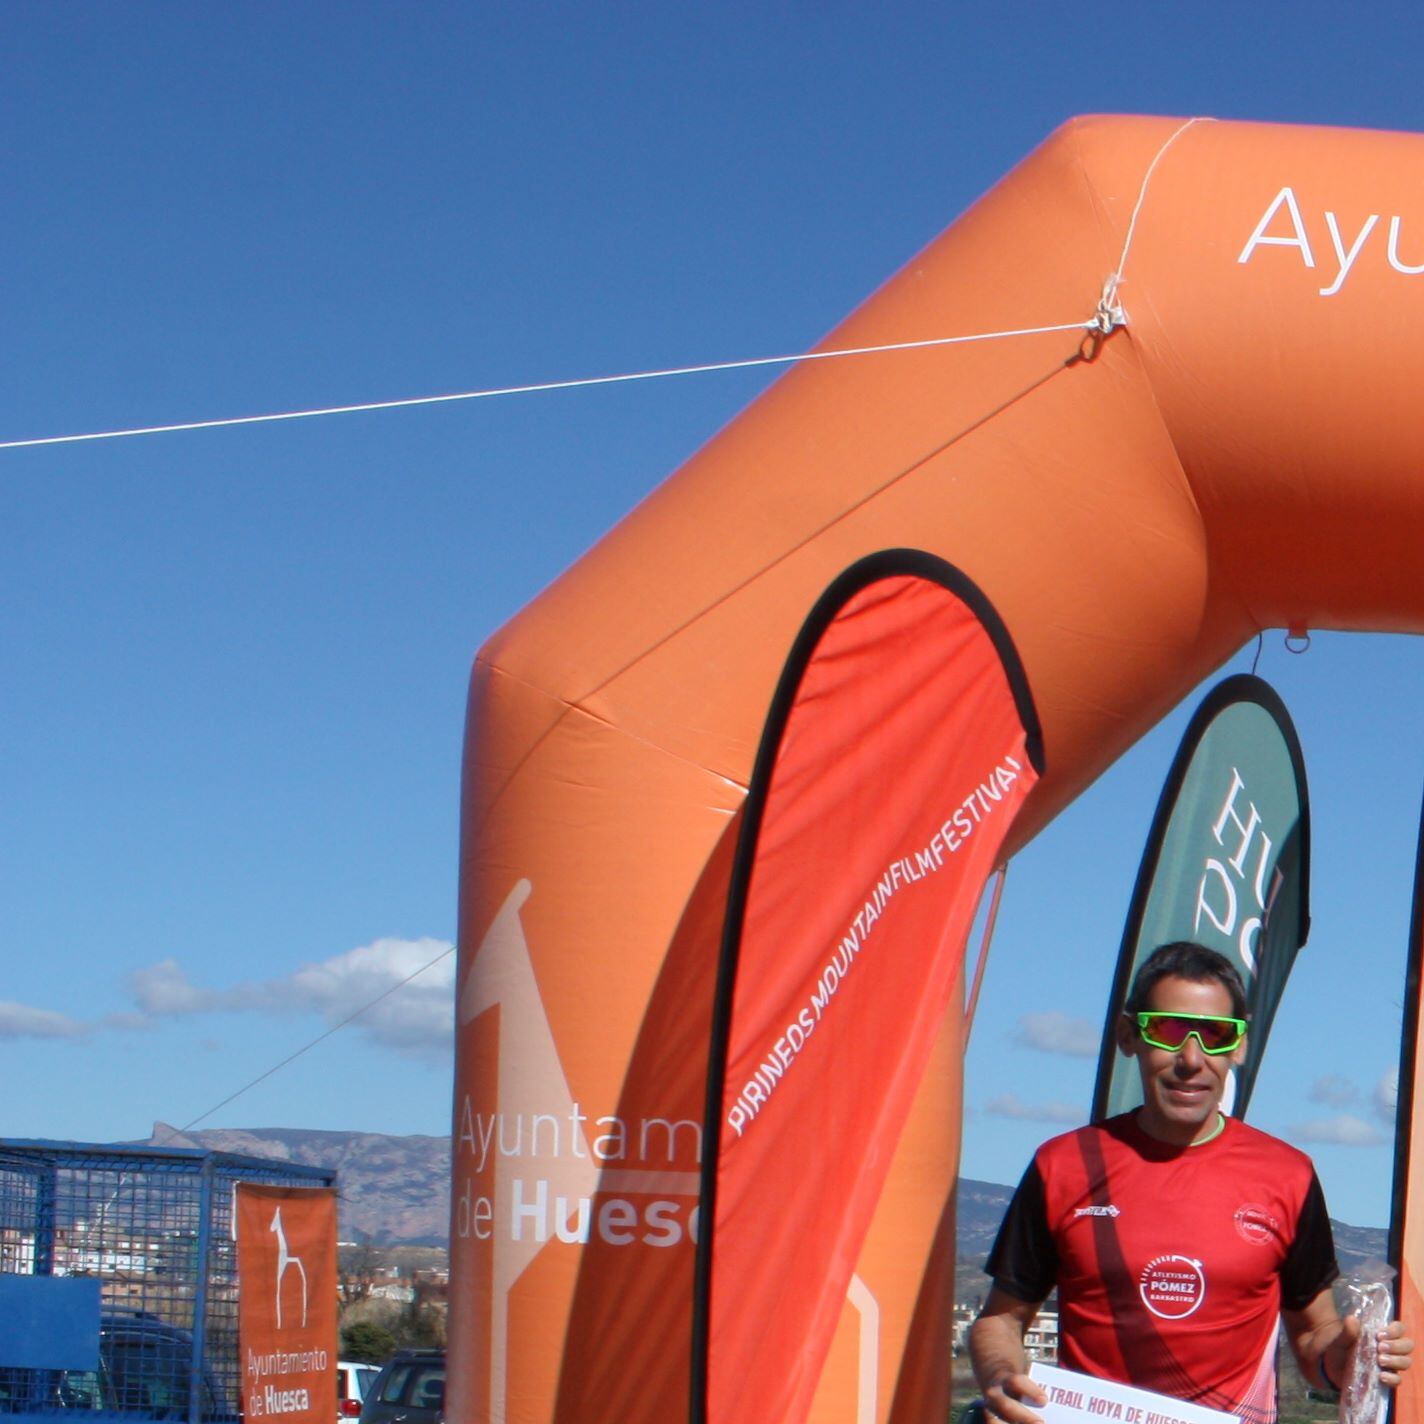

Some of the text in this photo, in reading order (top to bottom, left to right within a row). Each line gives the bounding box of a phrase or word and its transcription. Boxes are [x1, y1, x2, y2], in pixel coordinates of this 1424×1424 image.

[459, 1095, 702, 1173] Ayuntam
[457, 1178, 492, 1239] de
[1151, 1278, 1195, 1294] PÓMEZ
[248, 1344, 327, 1384] Ayuntamiento
[249, 1385, 310, 1416] de Huesca
[1050, 1386, 1084, 1410] TRAIL
[1087, 1396, 1121, 1420] HOYA
[1127, 1407, 1143, 1424] DE
